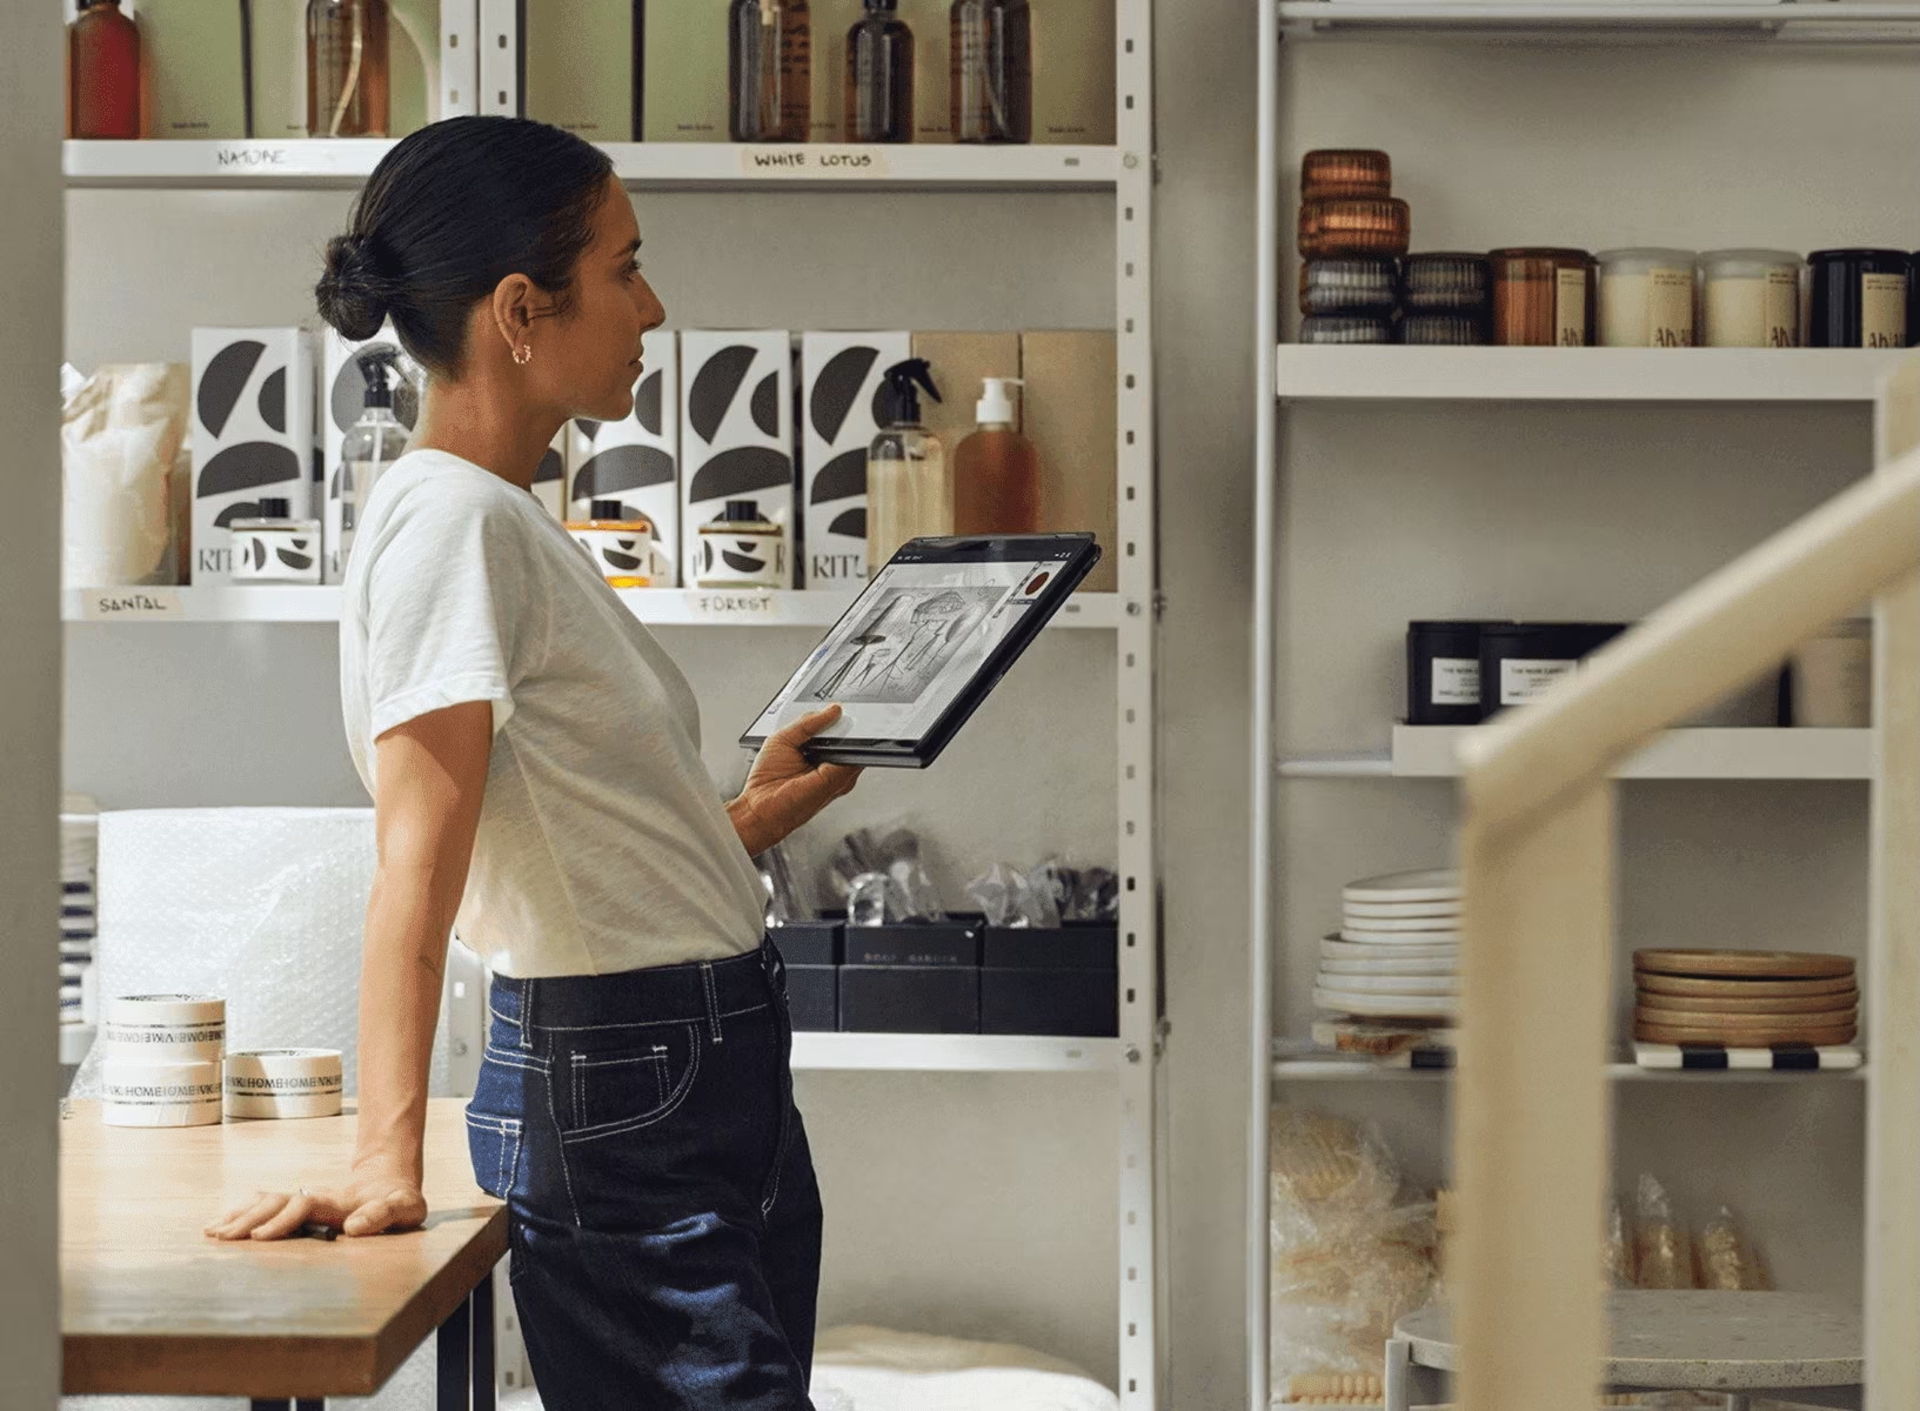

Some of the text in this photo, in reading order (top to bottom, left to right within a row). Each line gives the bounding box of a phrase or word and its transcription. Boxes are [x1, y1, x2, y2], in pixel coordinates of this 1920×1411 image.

[217, 149, 285, 165] NATURE
[754, 153, 871, 167] WHITE LOTUS
[99, 595, 167, 612] SANTAL
[700, 596, 771, 611] FOREST
